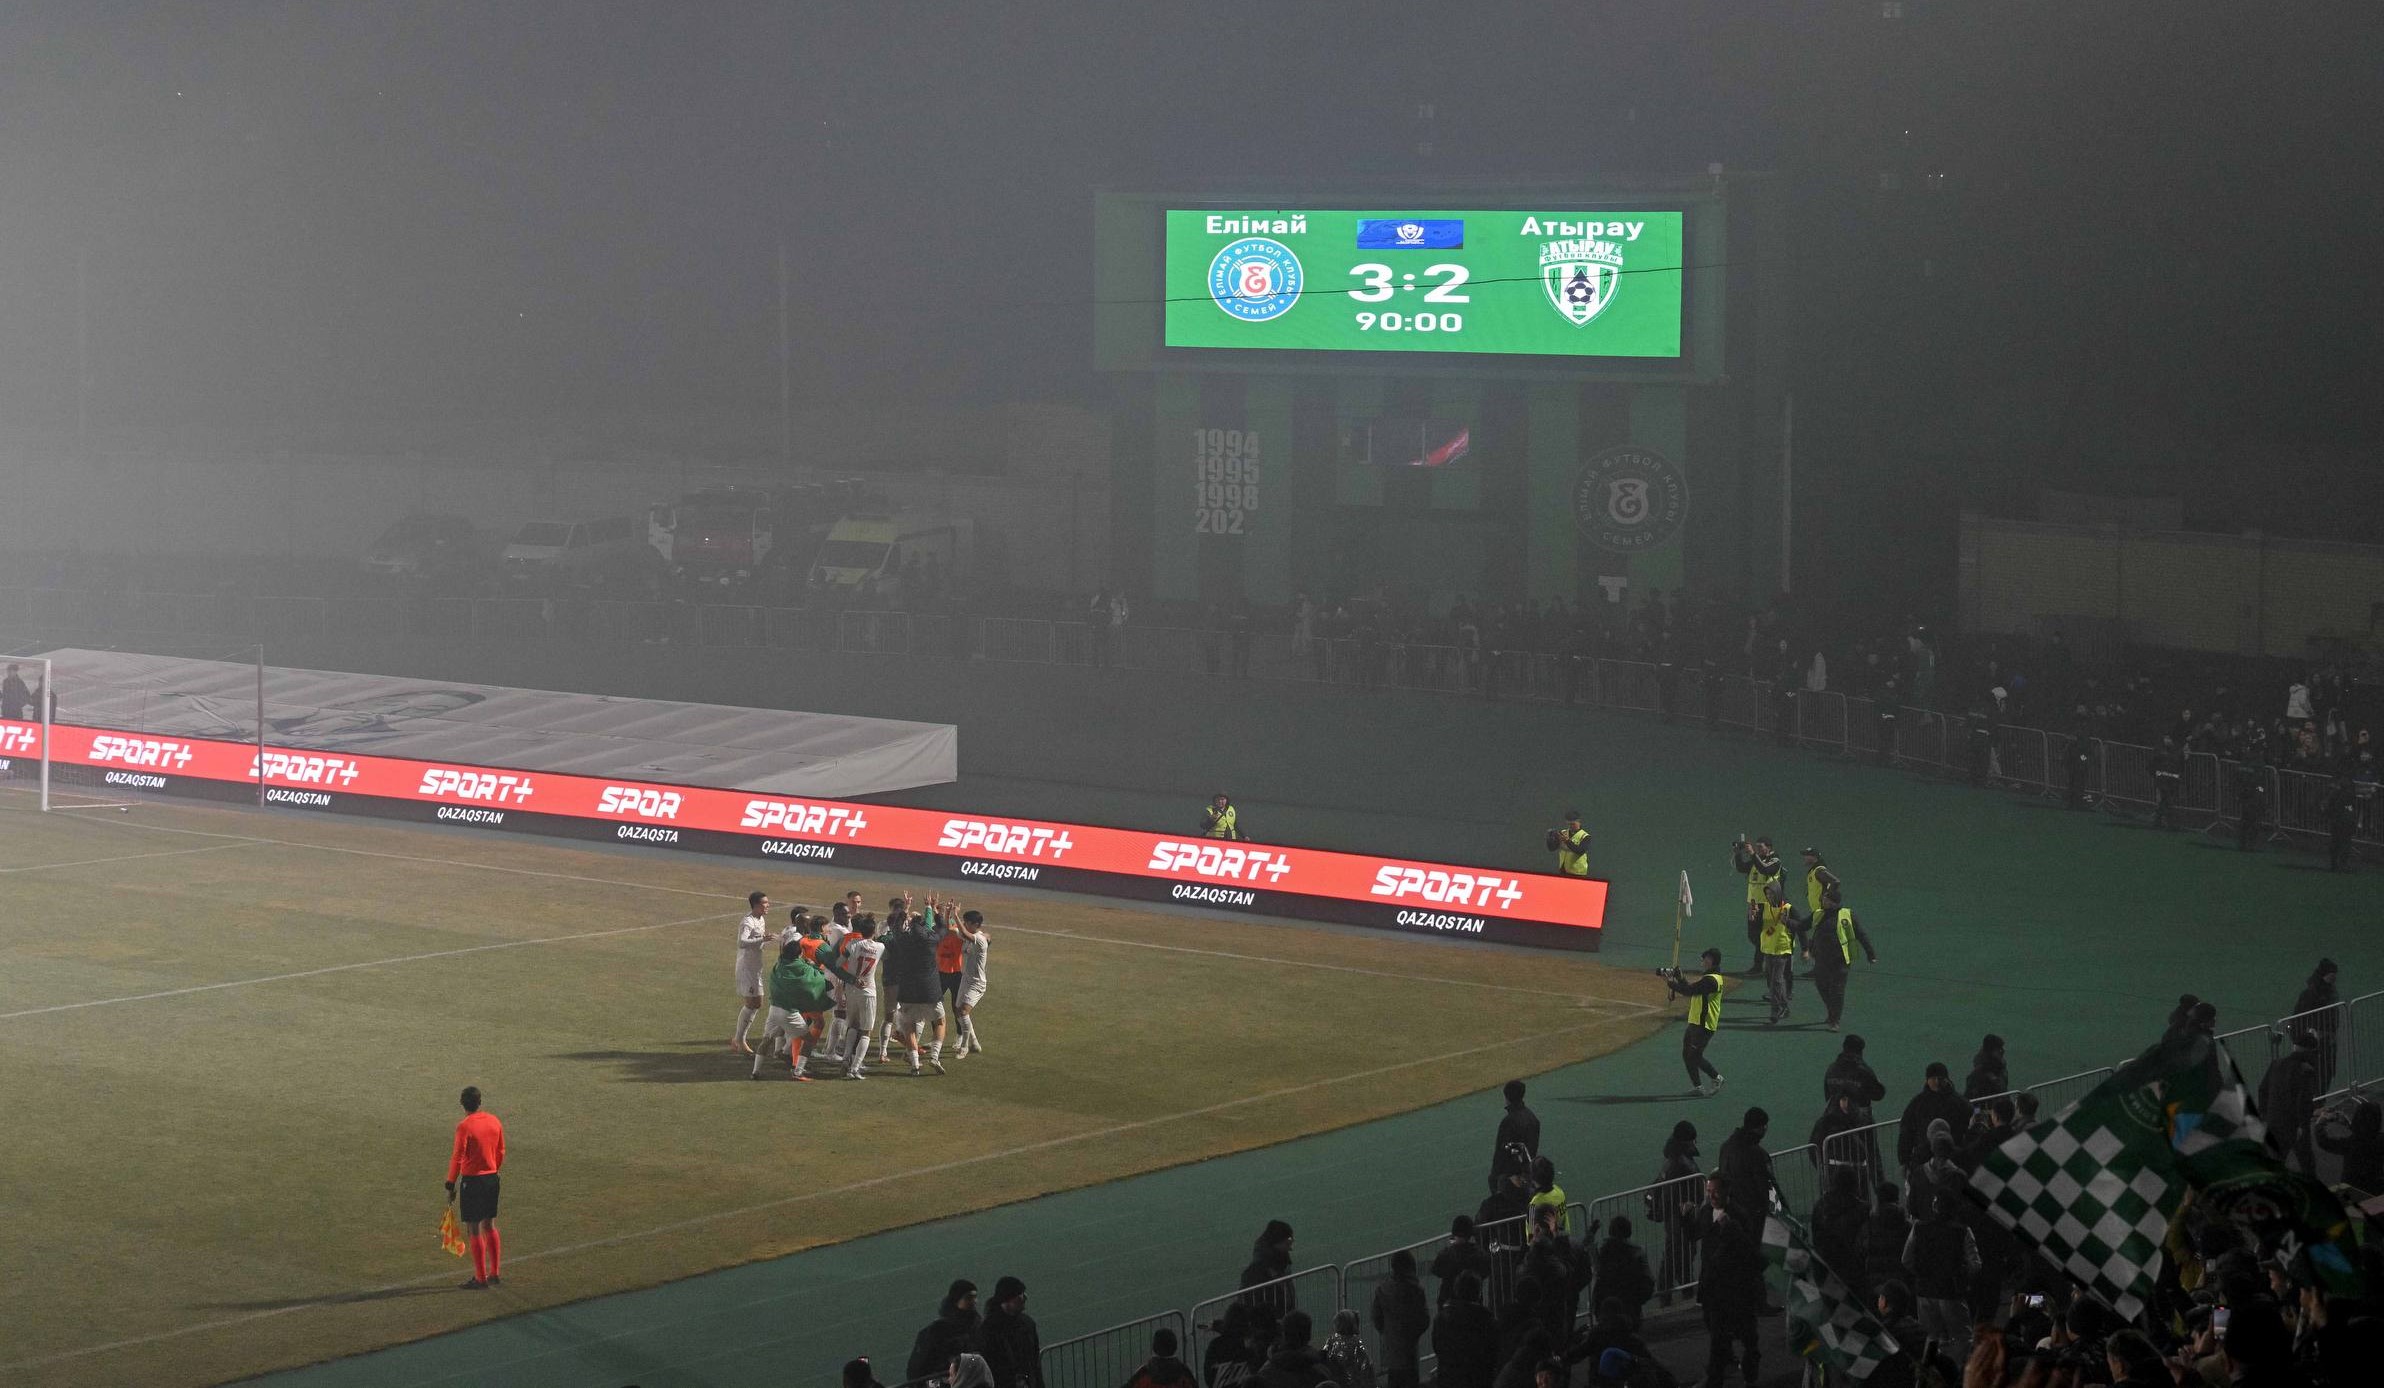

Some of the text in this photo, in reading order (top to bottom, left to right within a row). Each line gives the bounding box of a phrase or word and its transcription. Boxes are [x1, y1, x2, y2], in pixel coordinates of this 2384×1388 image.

[1206, 214, 1307, 234] Елімай
[1520, 216, 1644, 241] Атырау
[1234, 243, 1283, 257] ФУТБОЛ
[1549, 239, 1616, 254] АТЫРАУ
[1347, 263, 1470, 303] 3:2
[1234, 303, 1277, 315] СЕМЕЙ
[1355, 312, 1463, 332] 90:00
[1193, 428, 1260, 459] 1994
[1194, 456, 1260, 484] 1995
[1602, 454, 1661, 472] ФУТБОЛ
[1193, 481, 1259, 511] 1998
[1602, 531, 1653, 546] СЕМЕЙ
[88, 735, 193, 768] SPORT+
[104, 771, 166, 788] QAZAQSTAN
[248, 753, 359, 786] SPORT+
[417, 768, 534, 803] SPORT+
[263, 788, 331, 806] QAZAQSTAN
[437, 806, 504, 824] QAZAQSTAN
[739, 799, 868, 838] SPORT+
[761, 840, 835, 859] QAZAQSTAN
[937, 819, 1074, 859] SPORT+
[960, 861, 1040, 881] QAZAQSTAN
[1147, 841, 1291, 883] SPORT+
[1172, 884, 1255, 906] QAZAQSTAN
[1370, 865, 1523, 910] SPORT+
[1396, 910, 1485, 933] QAZAQSTAN
[857, 956, 877, 978] 17
